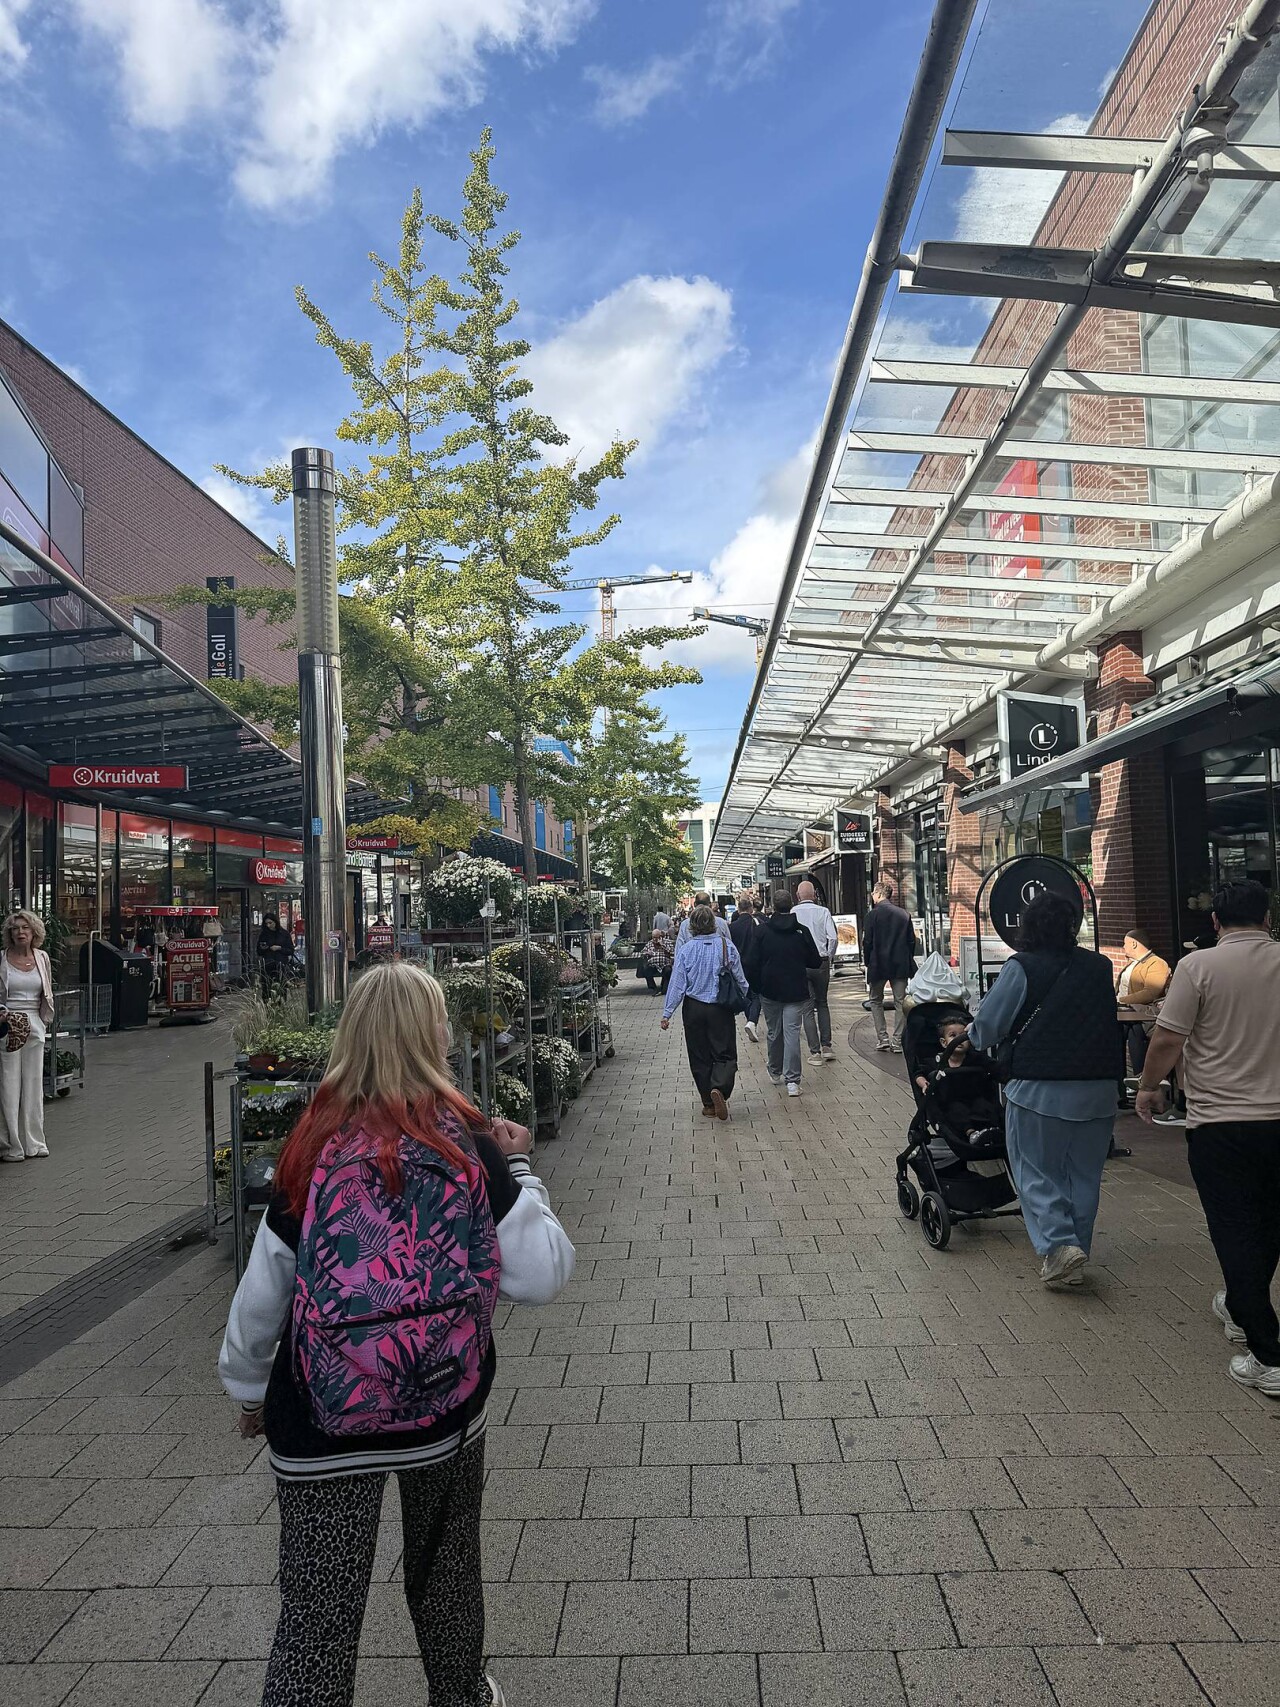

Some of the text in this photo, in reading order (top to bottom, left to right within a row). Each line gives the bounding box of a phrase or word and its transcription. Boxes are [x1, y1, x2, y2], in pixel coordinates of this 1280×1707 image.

[94, 769, 160, 784] Kruidvat
[358, 839, 388, 847] Kruidvat
[177, 941, 205, 949] Kruidvat
[172, 953, 204, 963] ACTIE!
[424, 1365, 454, 1383] EASTPAK
